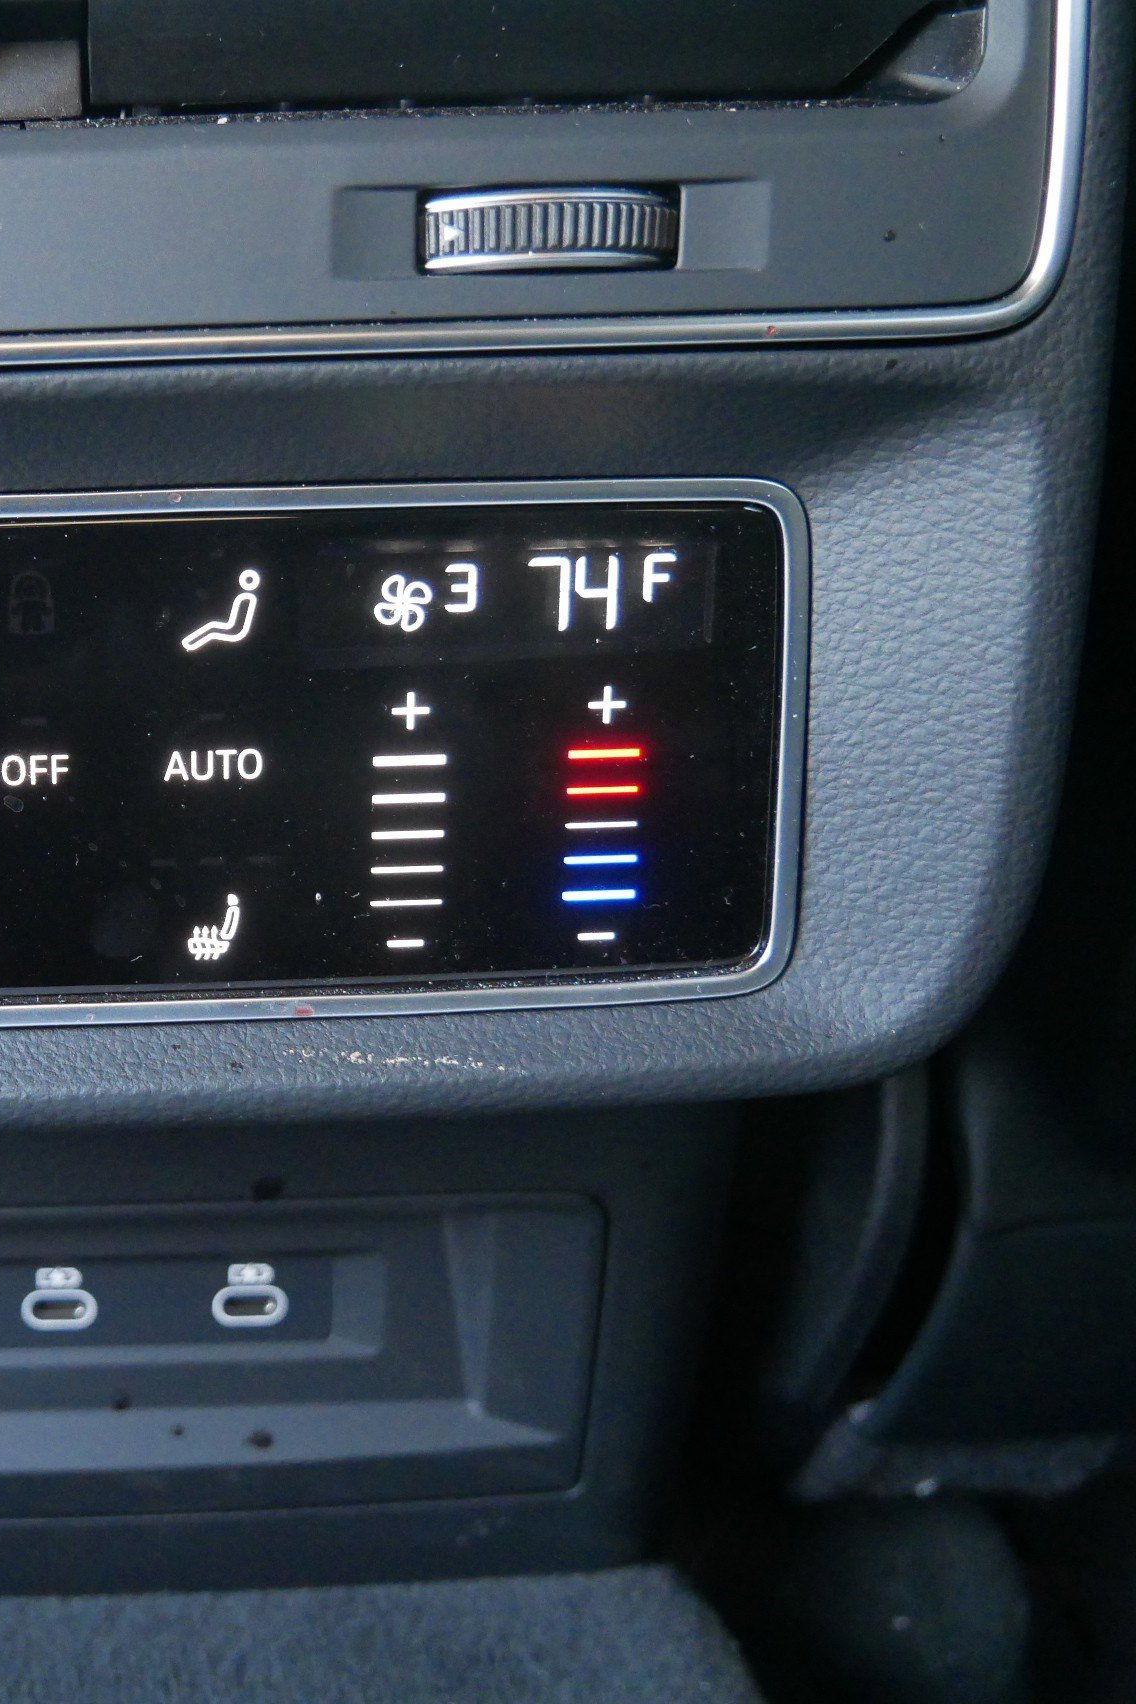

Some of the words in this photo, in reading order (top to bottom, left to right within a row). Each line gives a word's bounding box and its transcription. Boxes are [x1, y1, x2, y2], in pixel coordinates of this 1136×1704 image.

[443, 562, 479, 614] 3
[0, 753, 70, 787] OFF
[163, 747, 264, 782] AUTO
